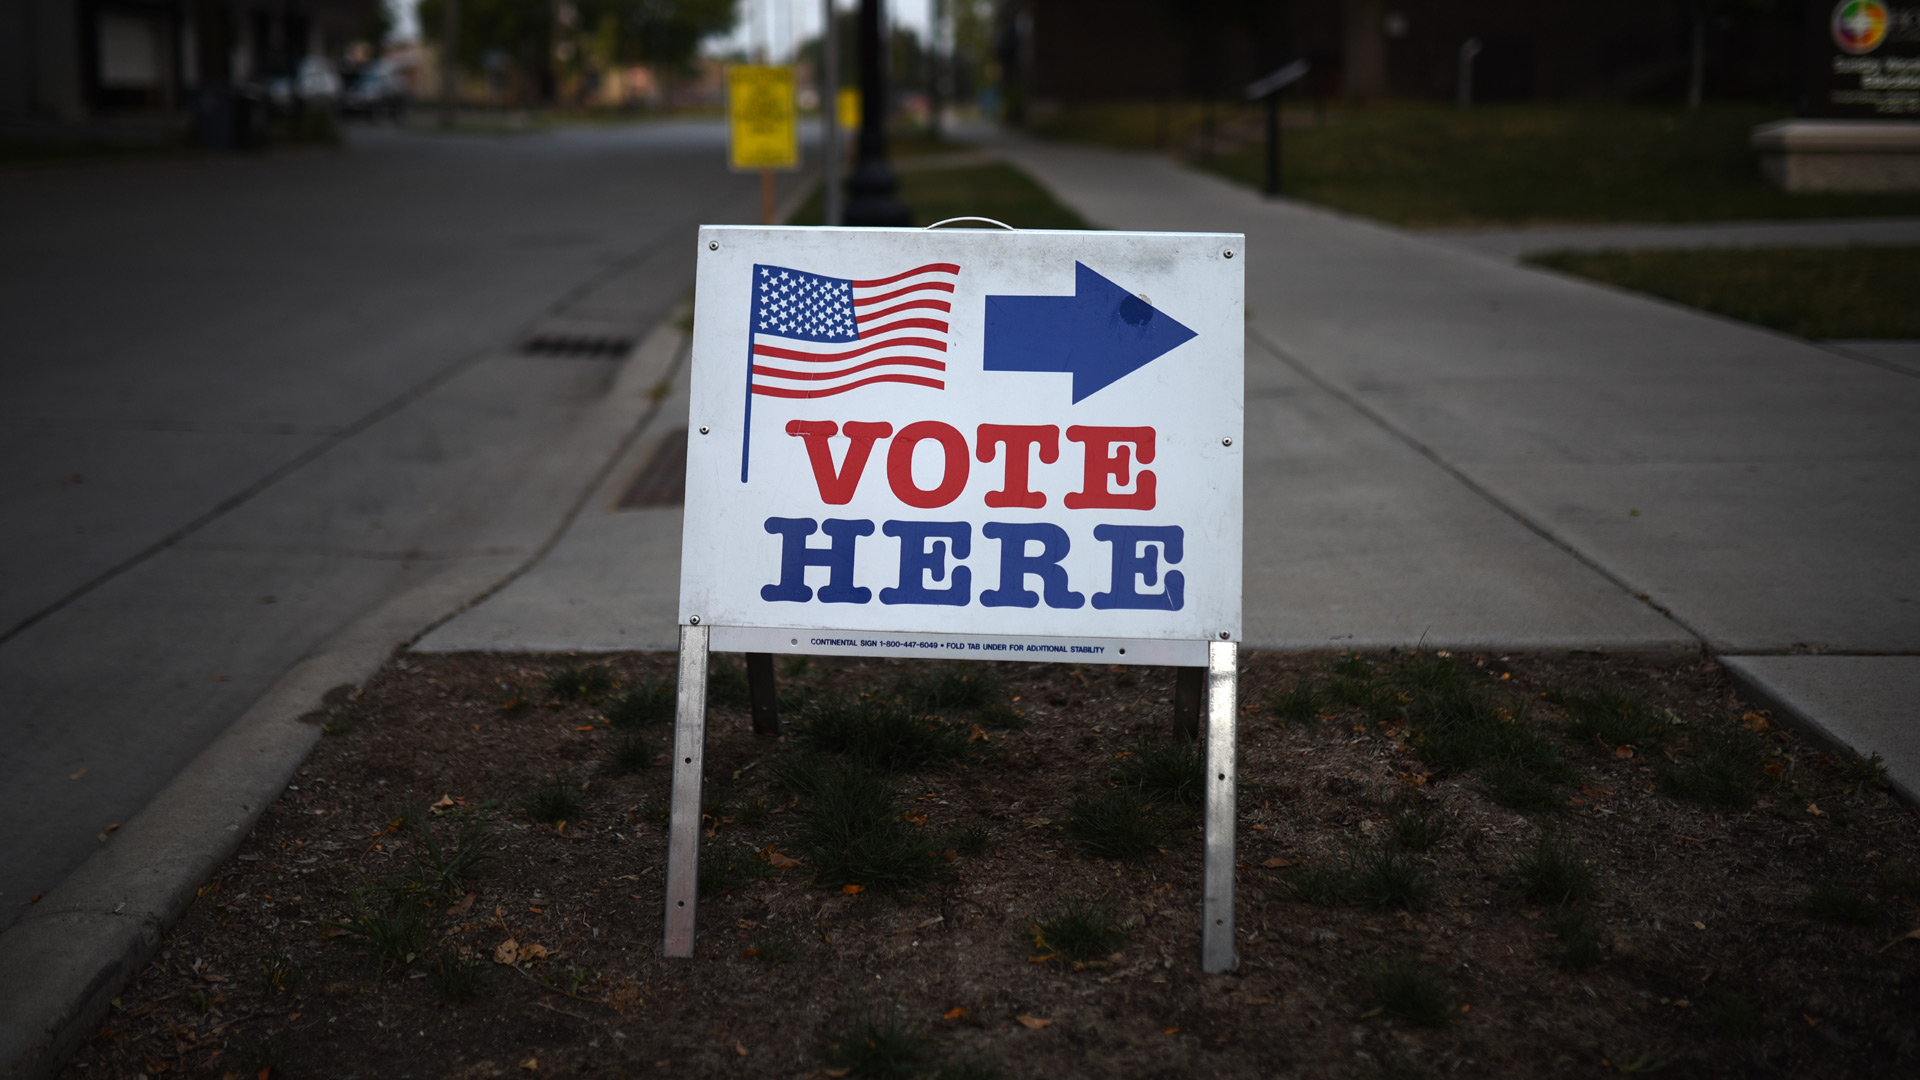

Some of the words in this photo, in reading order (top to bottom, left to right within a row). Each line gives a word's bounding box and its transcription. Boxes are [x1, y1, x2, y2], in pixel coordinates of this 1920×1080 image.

[786, 420, 1156, 510] VOTE
[761, 517, 1184, 611] HERE
[810, 638, 858, 647] CONTINENTAL
[860, 639, 877, 647] SIGN
[879, 640, 938, 649] 1-800-447-6049
[946, 642, 966, 650] FOLD
[967, 642, 980, 650] TAB
[982, 643, 1007, 651] UNDER
[1008, 644, 1025, 652] FOR
[1070, 646, 1104, 654] STABILITY
